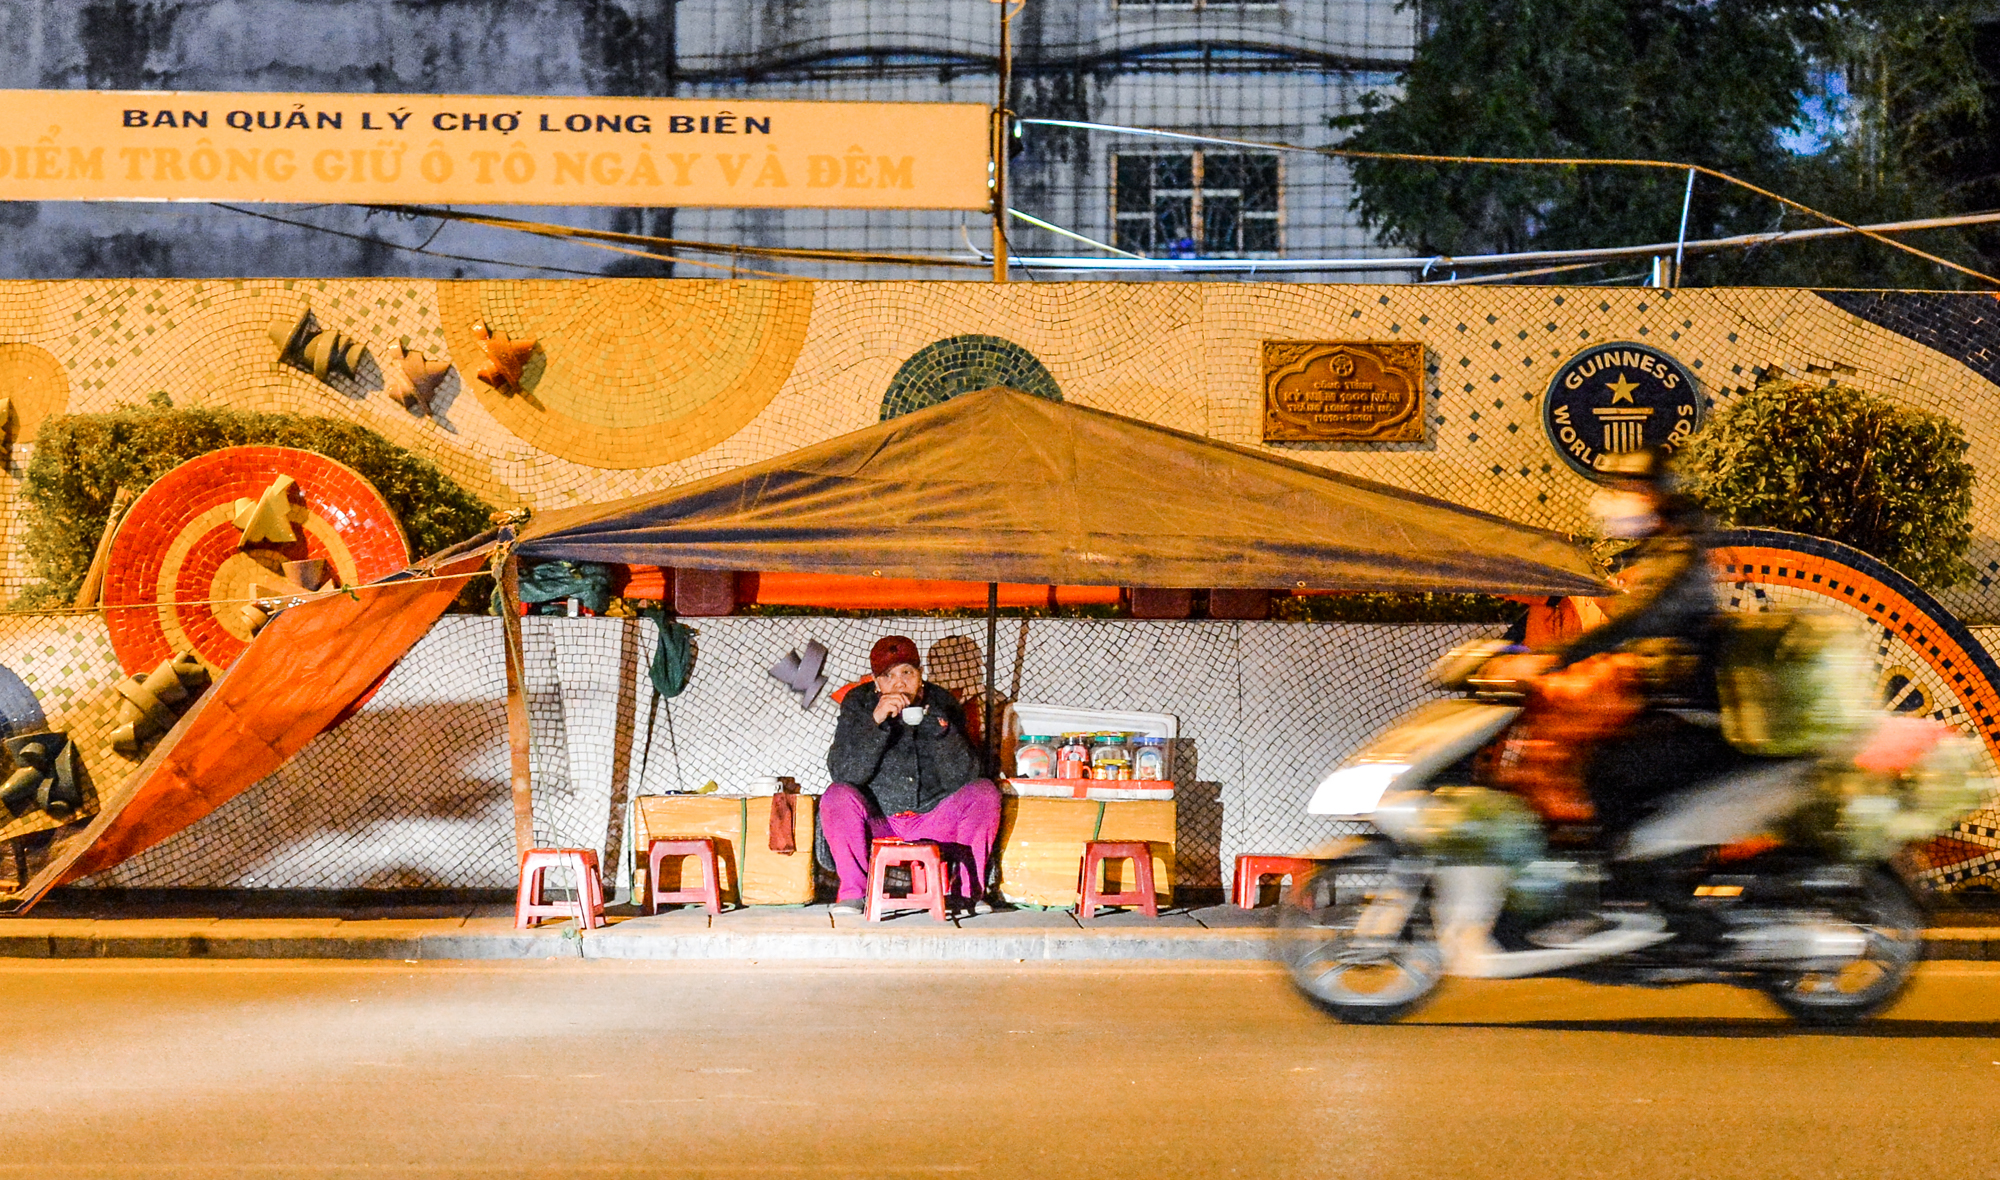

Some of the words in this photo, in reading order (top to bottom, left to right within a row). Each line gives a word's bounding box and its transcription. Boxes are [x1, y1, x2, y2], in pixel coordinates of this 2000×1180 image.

[123, 110, 208, 128] BAN
[226, 104, 343, 132] QUẢN
[362, 107, 412, 130] LÝ
[433, 110, 522, 136] CHỢ
[540, 114, 651, 134] LONG
[669, 110, 771, 135] BIÊN
[119, 136, 297, 183] TRÔNG
[313, 139, 408, 184] GIỮ
[420, 140, 455, 185] Ô
[469, 141, 537, 185] TÔ
[553, 141, 702, 188] NGÀY
[716, 143, 790, 188] VÀ
[806, 144, 915, 190] ĐÊM
[1565, 351, 1680, 390] GUINNESS
